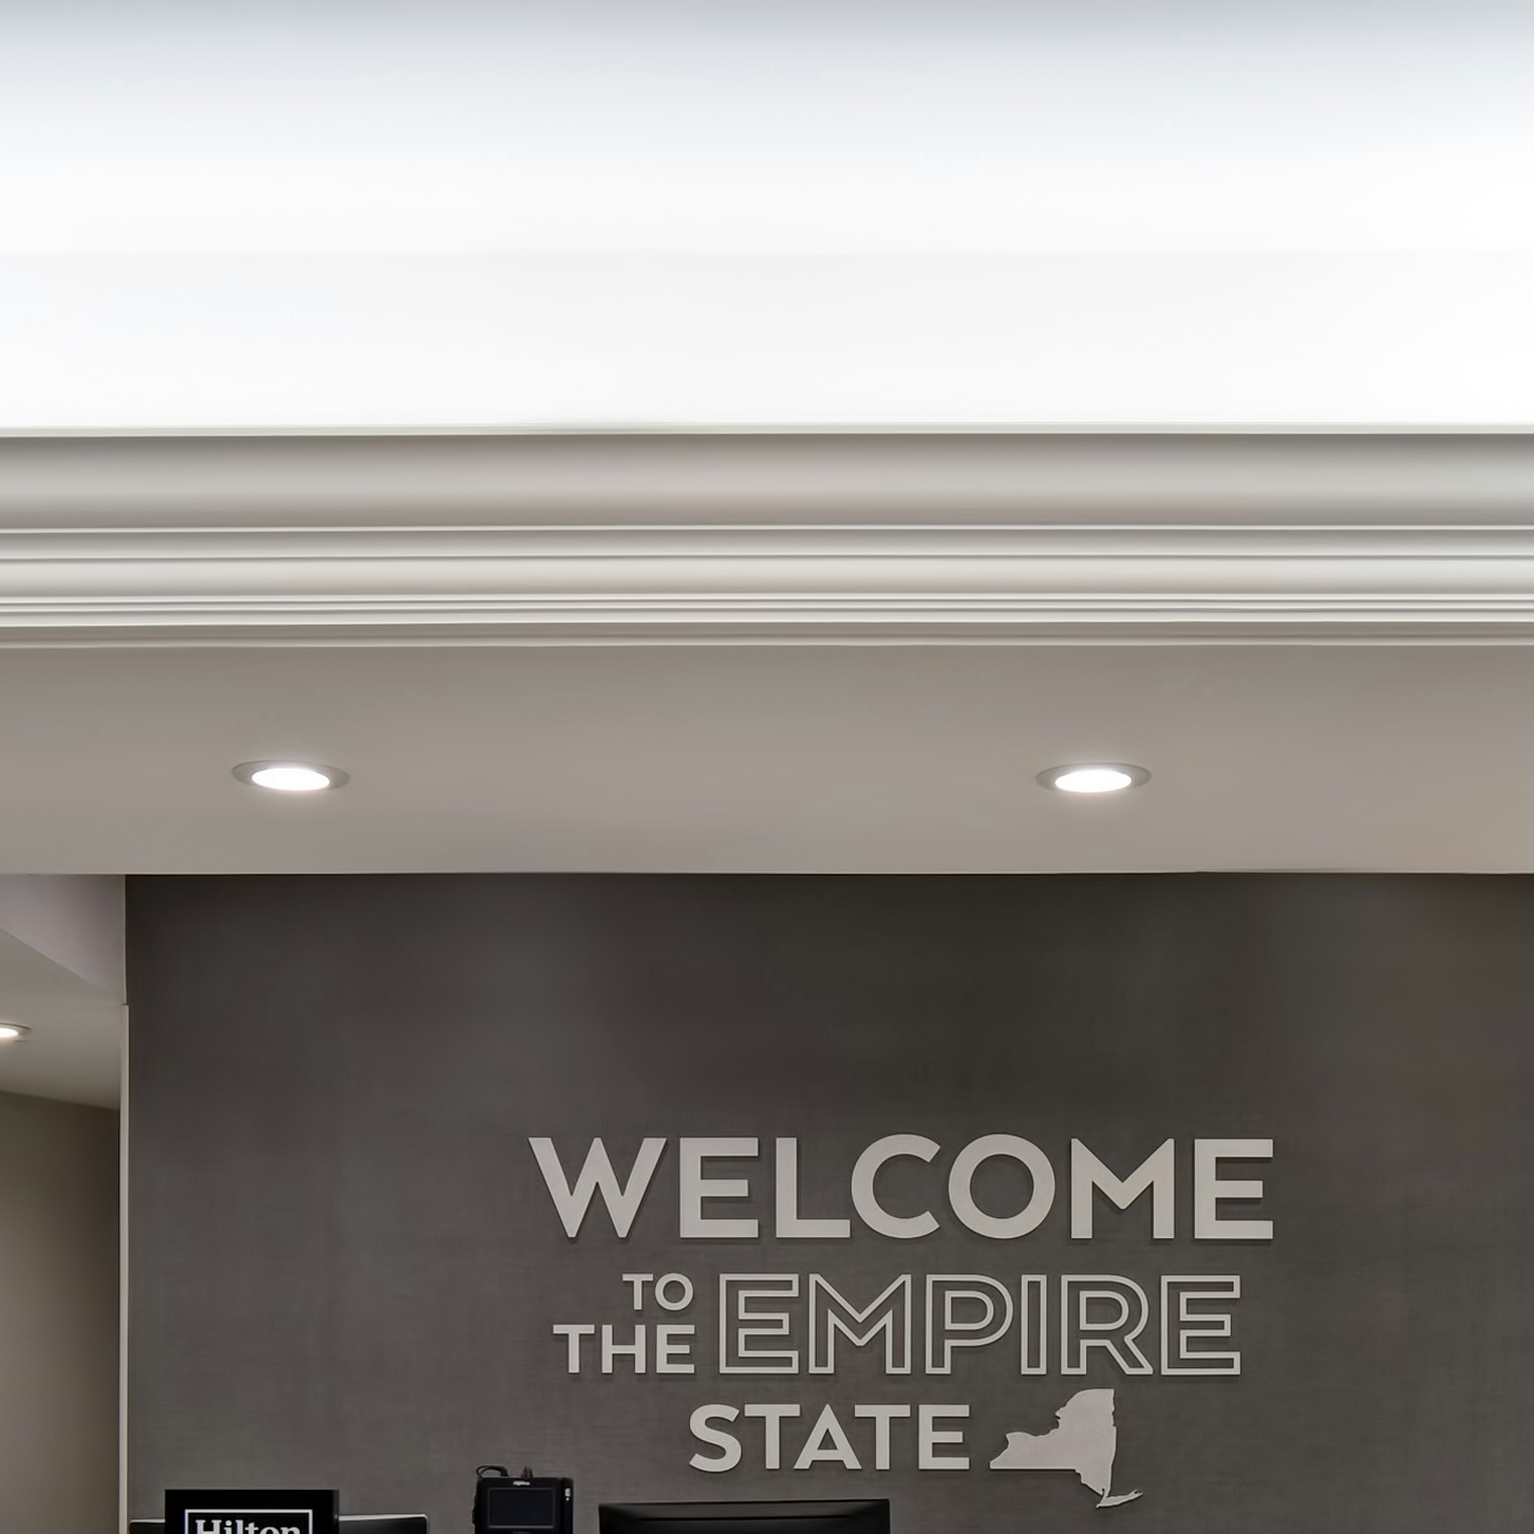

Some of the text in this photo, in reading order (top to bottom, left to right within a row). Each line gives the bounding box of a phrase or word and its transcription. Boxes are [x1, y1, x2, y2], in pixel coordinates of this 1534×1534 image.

[527, 1133, 1274, 1240] WELCOME
[552, 1272, 1242, 1377] THE EMPIRE
[622, 1271, 694, 1312] TO
[688, 1403, 970, 1473] STATE
